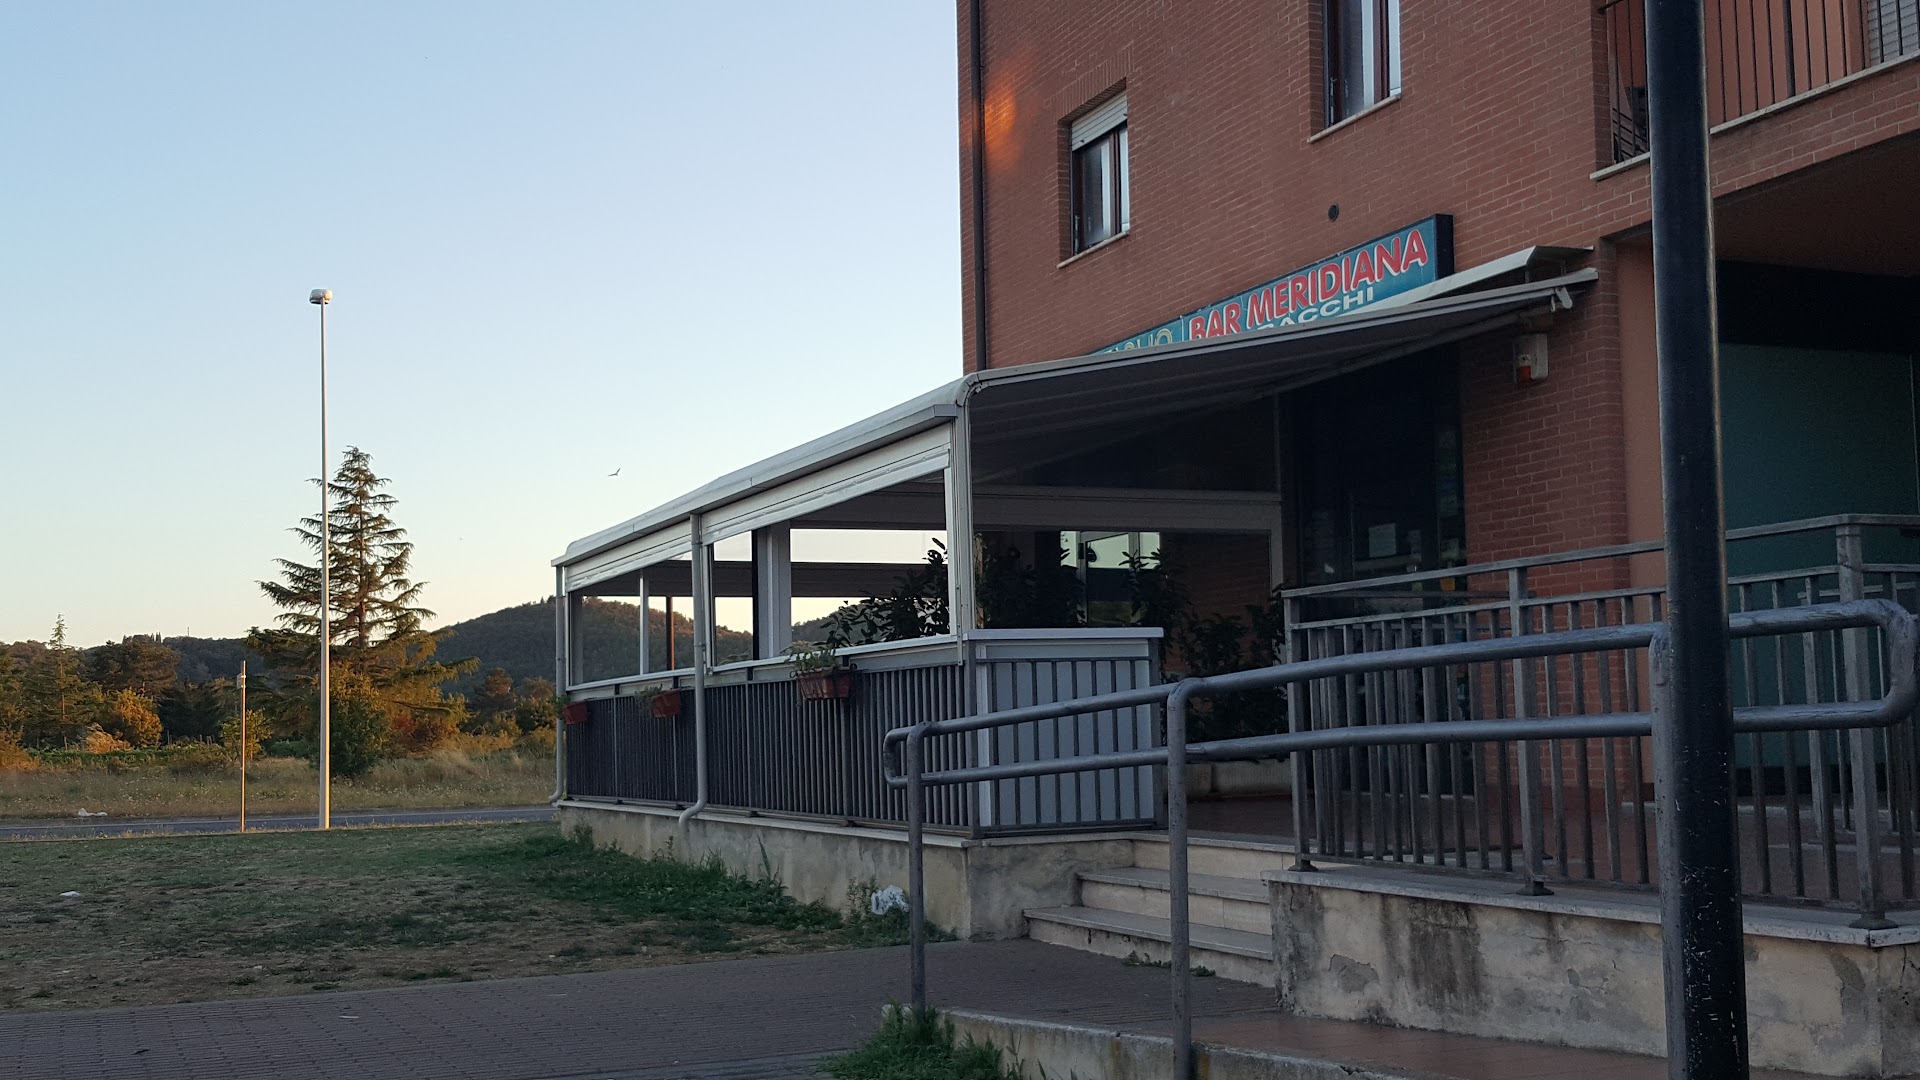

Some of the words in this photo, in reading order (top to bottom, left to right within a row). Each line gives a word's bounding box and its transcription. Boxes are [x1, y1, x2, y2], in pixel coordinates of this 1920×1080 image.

[1189, 303, 1241, 341] BAR
[1246, 229, 1428, 329] MERIDIANA
[1257, 286, 1374, 330] ACCHI
